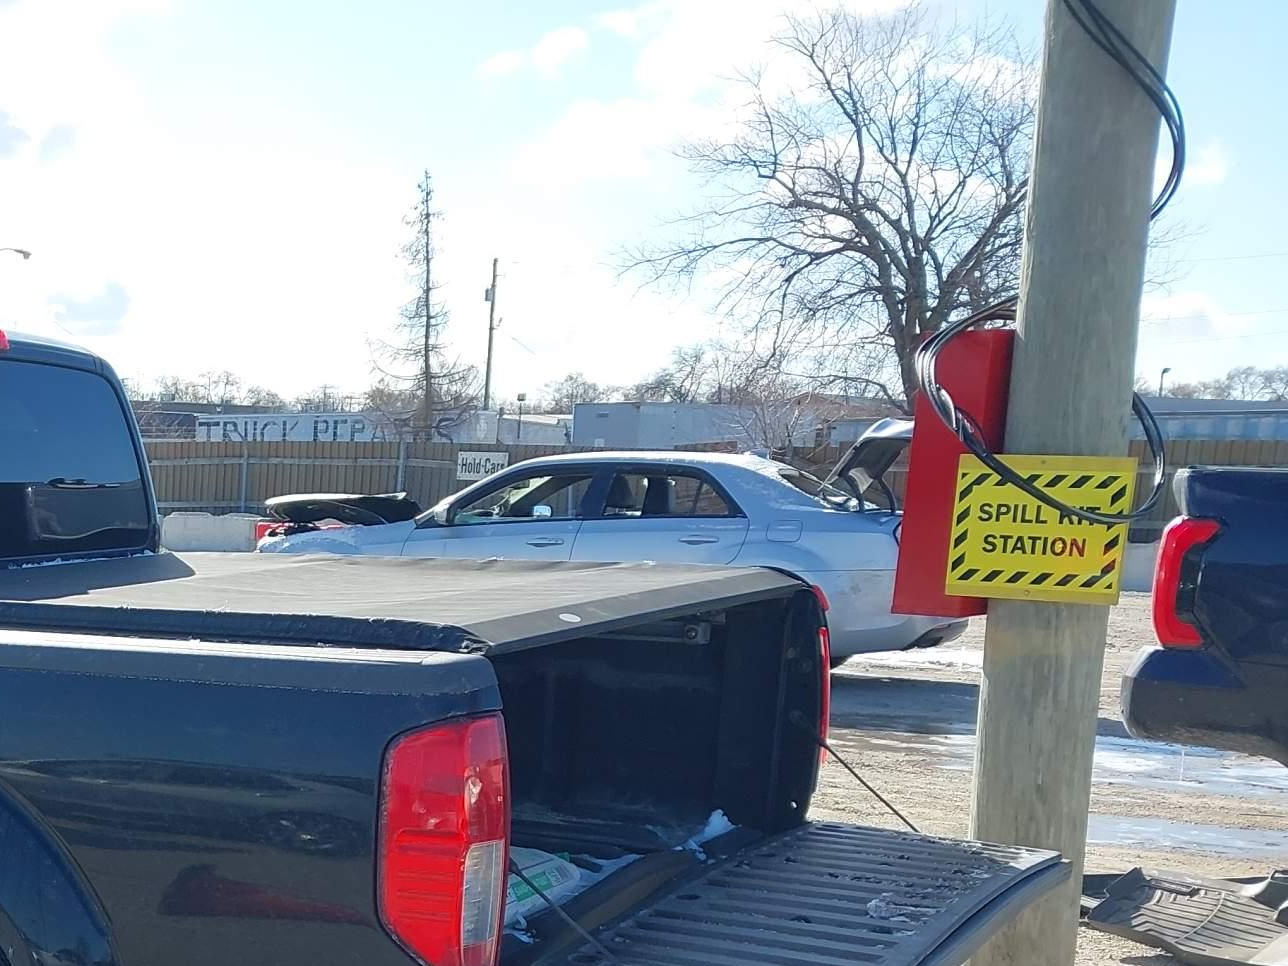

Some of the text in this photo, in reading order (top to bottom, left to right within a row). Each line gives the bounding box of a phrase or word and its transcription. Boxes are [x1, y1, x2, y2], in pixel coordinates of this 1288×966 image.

[461, 457, 482, 474] Hold
[978, 503, 1048, 524] SPILL
[982, 534, 1086, 557] STATION
